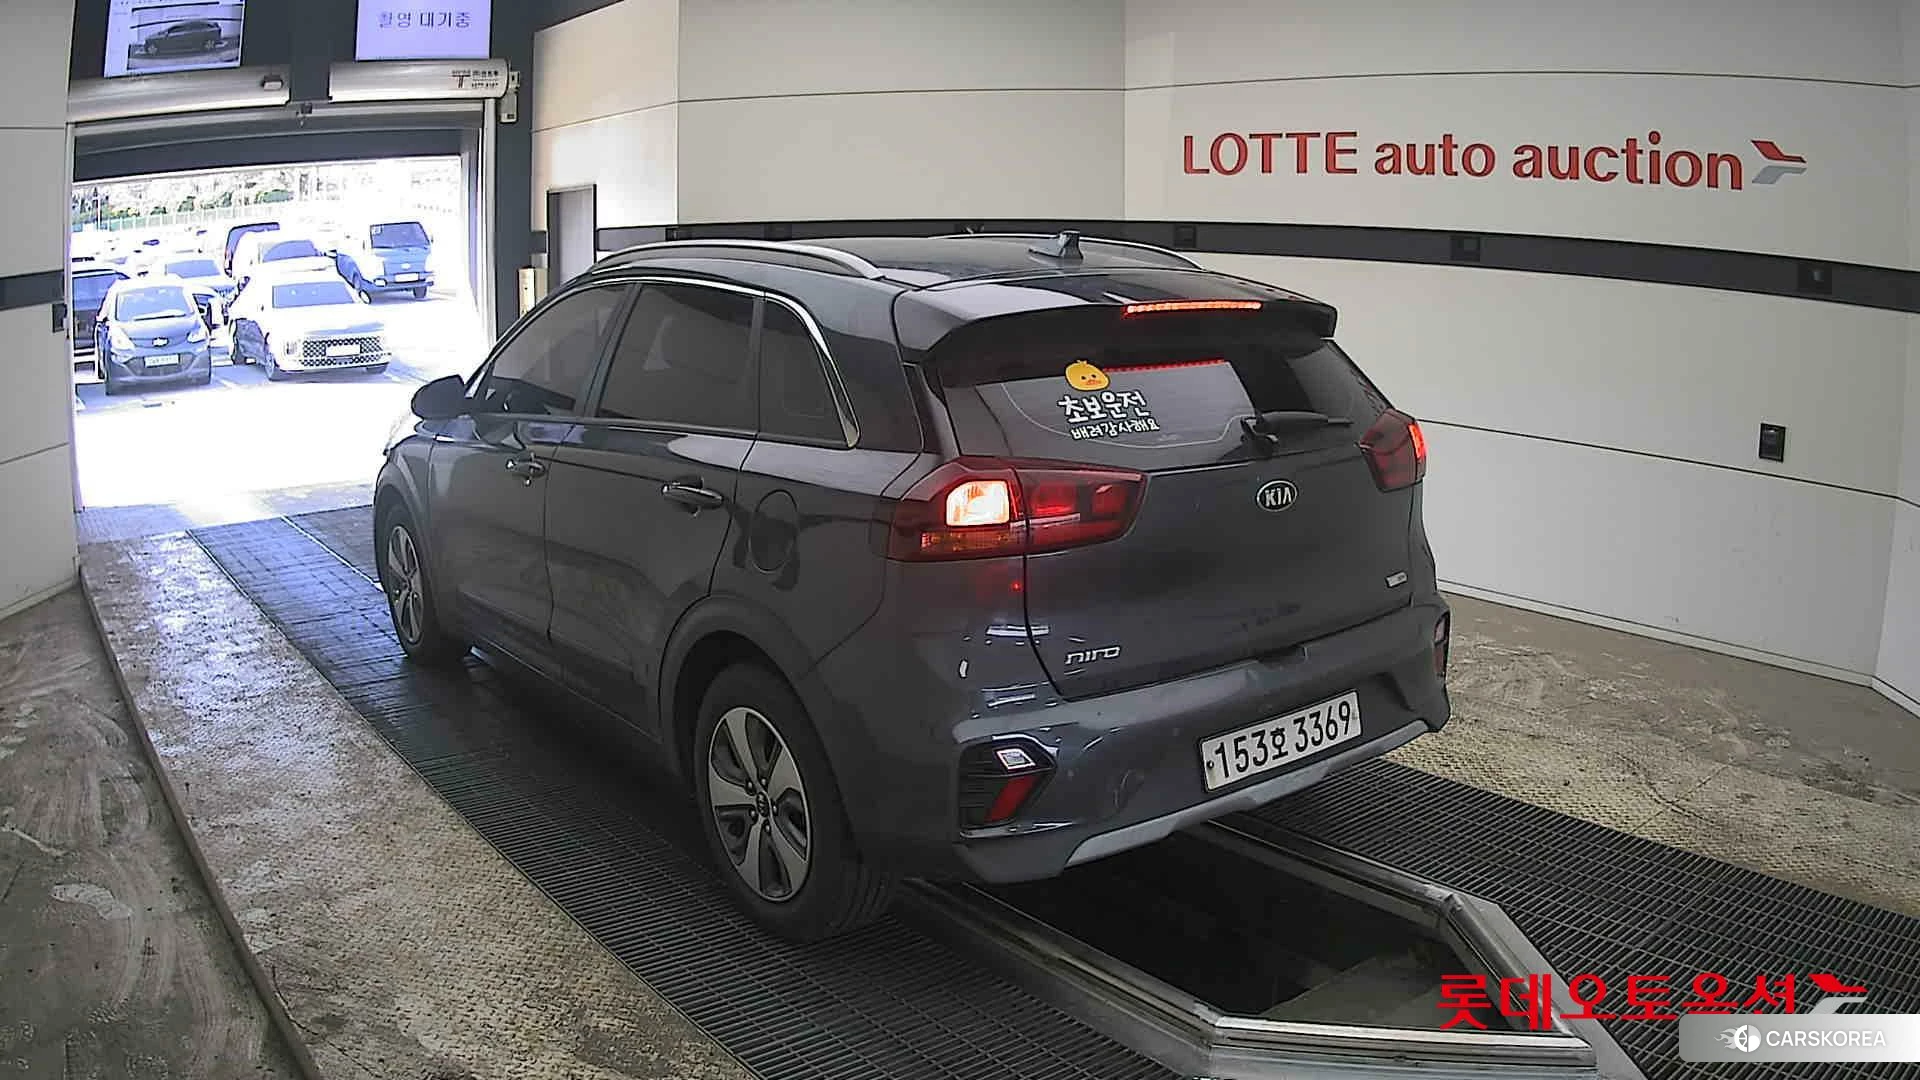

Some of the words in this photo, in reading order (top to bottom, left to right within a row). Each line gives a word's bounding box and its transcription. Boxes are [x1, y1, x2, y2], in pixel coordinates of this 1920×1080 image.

[419, 11, 472, 29] 대기중
[1183, 131, 1358, 175] LOTTE
[1375, 133, 1496, 178] auto
[1513, 131, 1744, 191] auction
[1057, 389, 1151, 424] 초보운전
[1071, 417, 1161, 440] 배려감사해요
[1263, 485, 1293, 507] KIA
[1214, 727, 1289, 778] 153호
[1293, 700, 1351, 753] 3369
